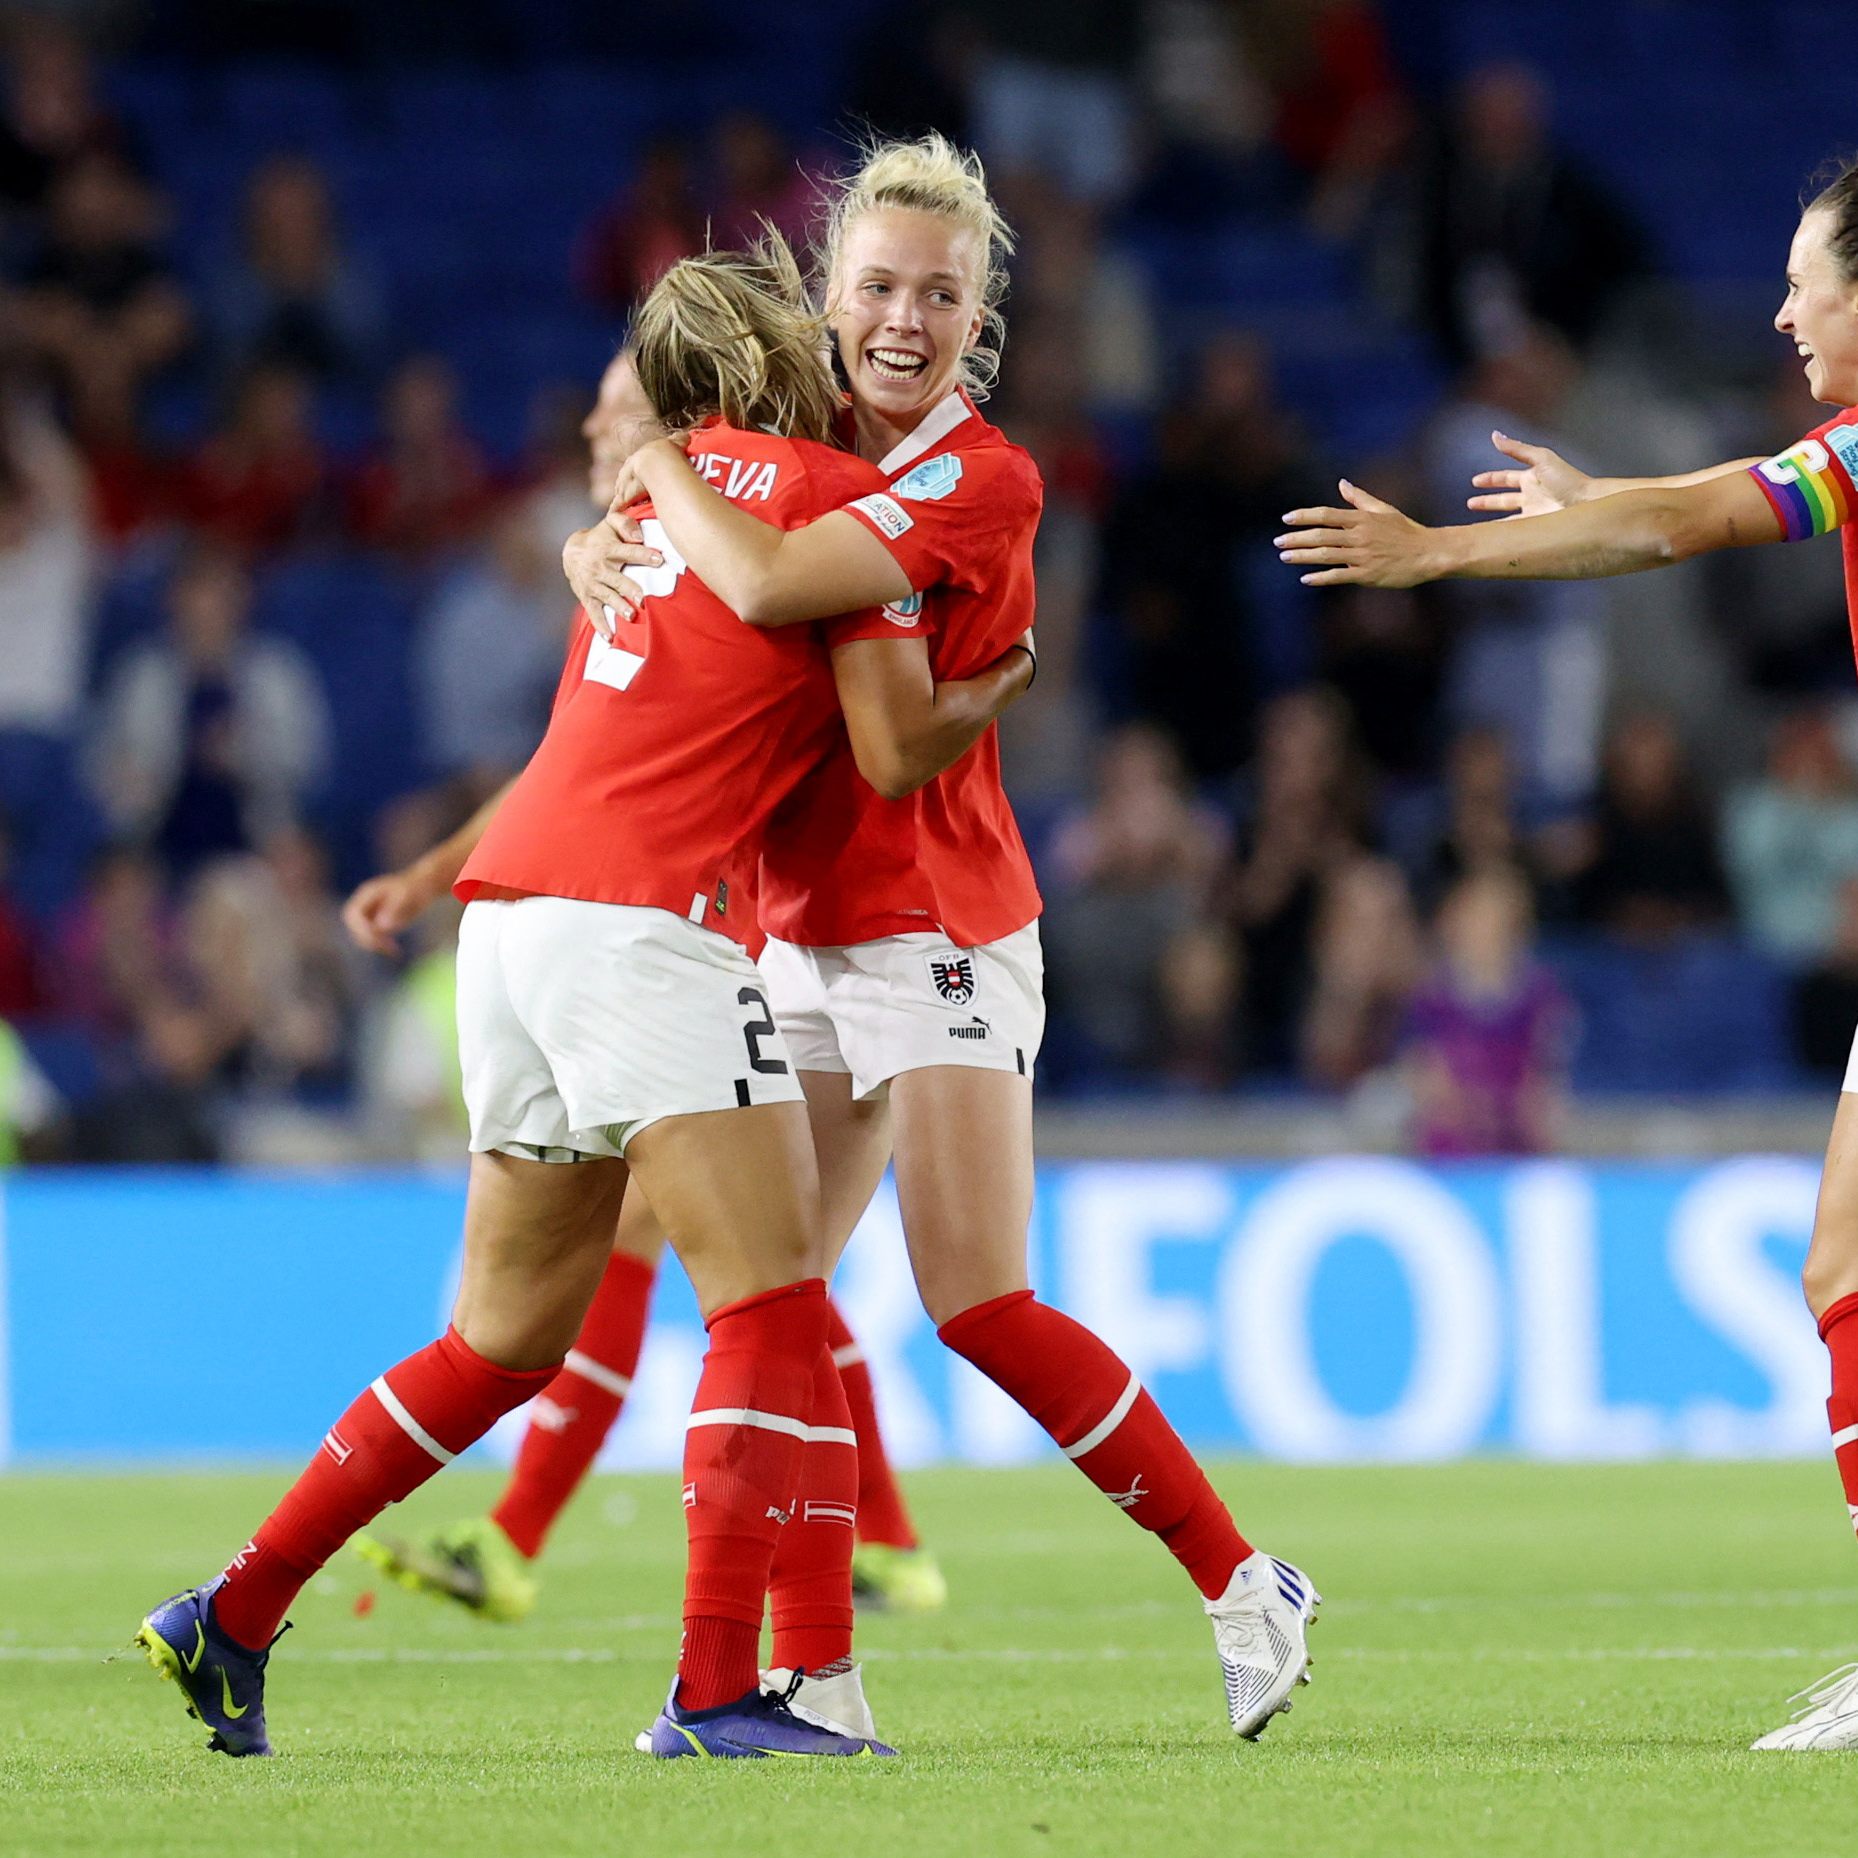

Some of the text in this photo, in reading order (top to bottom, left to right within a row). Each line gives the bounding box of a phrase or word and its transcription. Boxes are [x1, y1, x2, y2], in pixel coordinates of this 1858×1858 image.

[689, 453, 778, 501] EVA
[1759, 439, 1830, 485] C
[869, 499, 906, 532] ATION
[737, 987, 788, 1074] 2
[948, 1027, 986, 1039] PUMA
